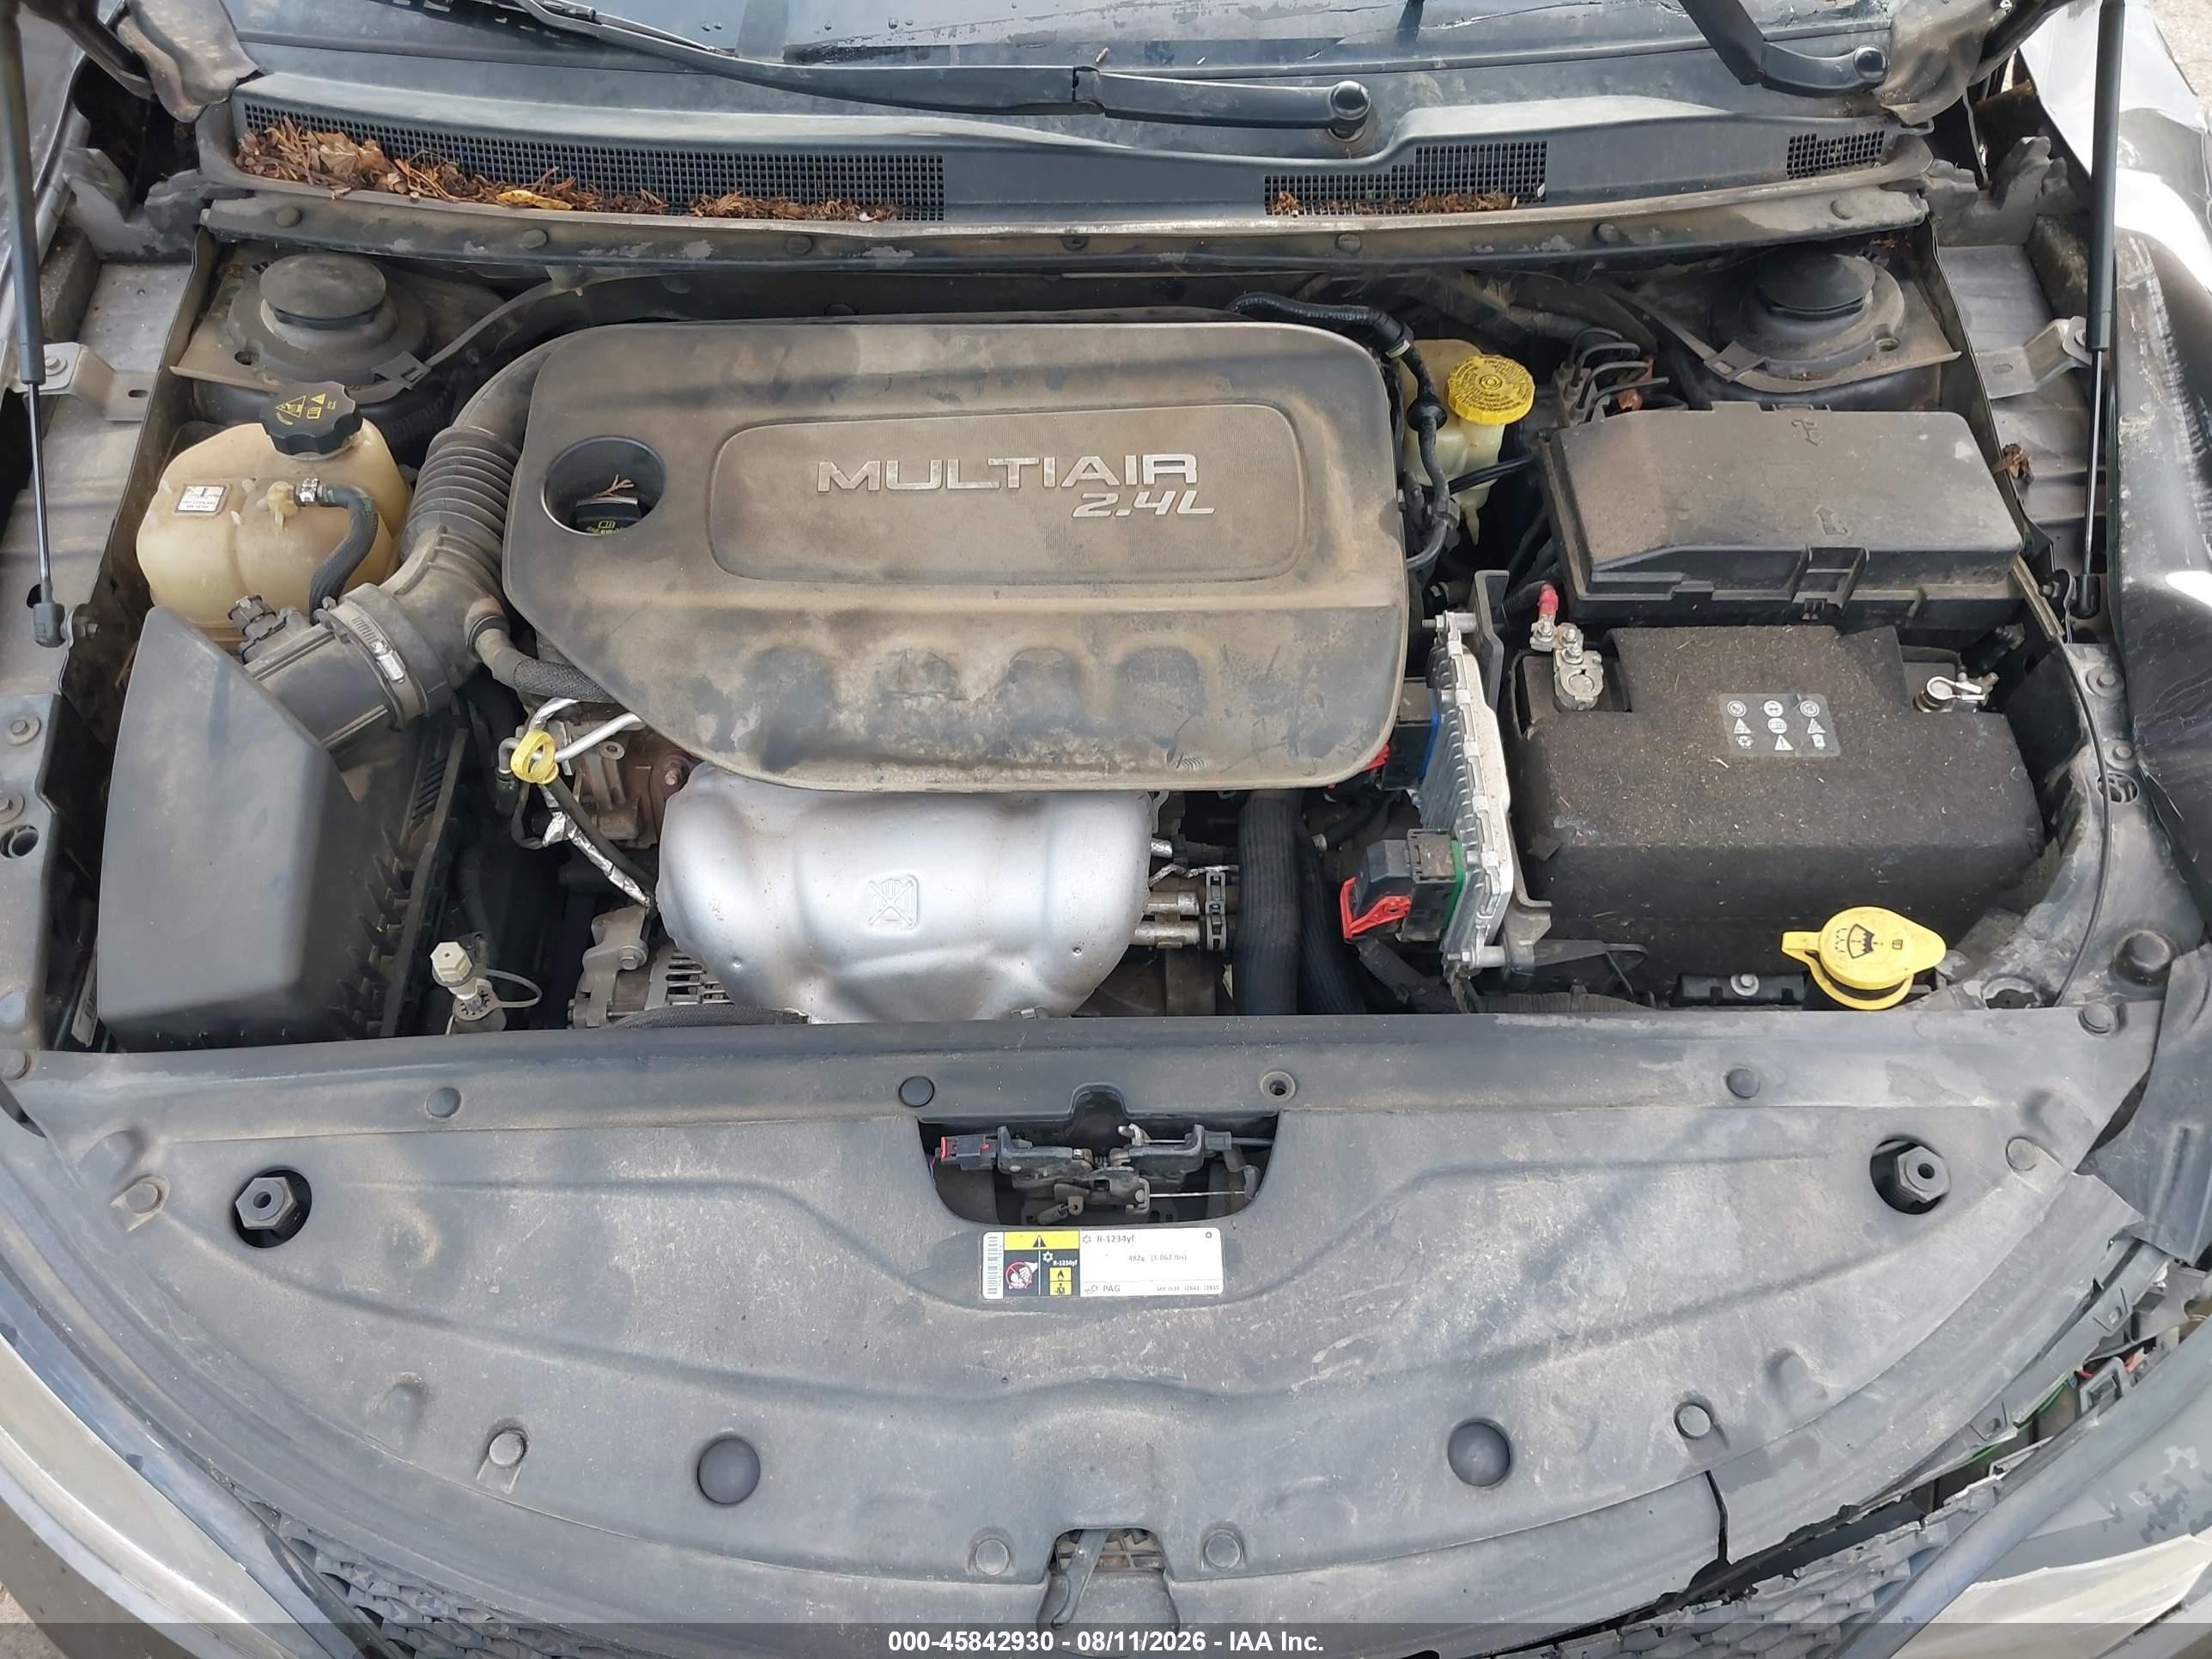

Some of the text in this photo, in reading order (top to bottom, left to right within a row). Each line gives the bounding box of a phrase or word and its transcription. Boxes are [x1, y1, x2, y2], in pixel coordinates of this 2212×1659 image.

[816, 453, 1199, 492] MULTIAIR
[1071, 489, 1216, 518] 2.4L
[1097, 1234, 1134, 1244] R-1234yf
